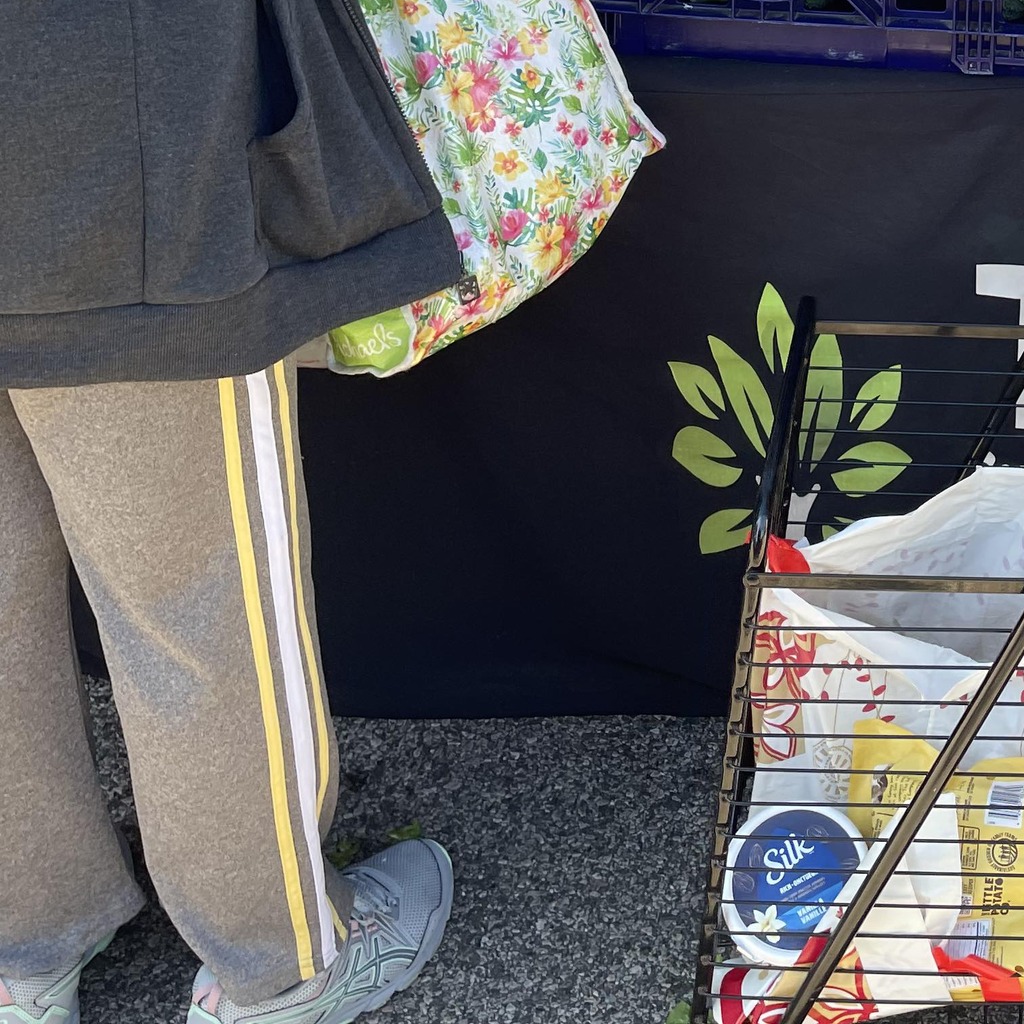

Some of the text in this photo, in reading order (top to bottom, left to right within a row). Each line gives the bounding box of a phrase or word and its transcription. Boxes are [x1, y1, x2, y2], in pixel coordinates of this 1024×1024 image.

[332, 322, 402, 359] ichaels
[763, 832, 815, 886] Silk
[797, 897, 825, 916] VANA
